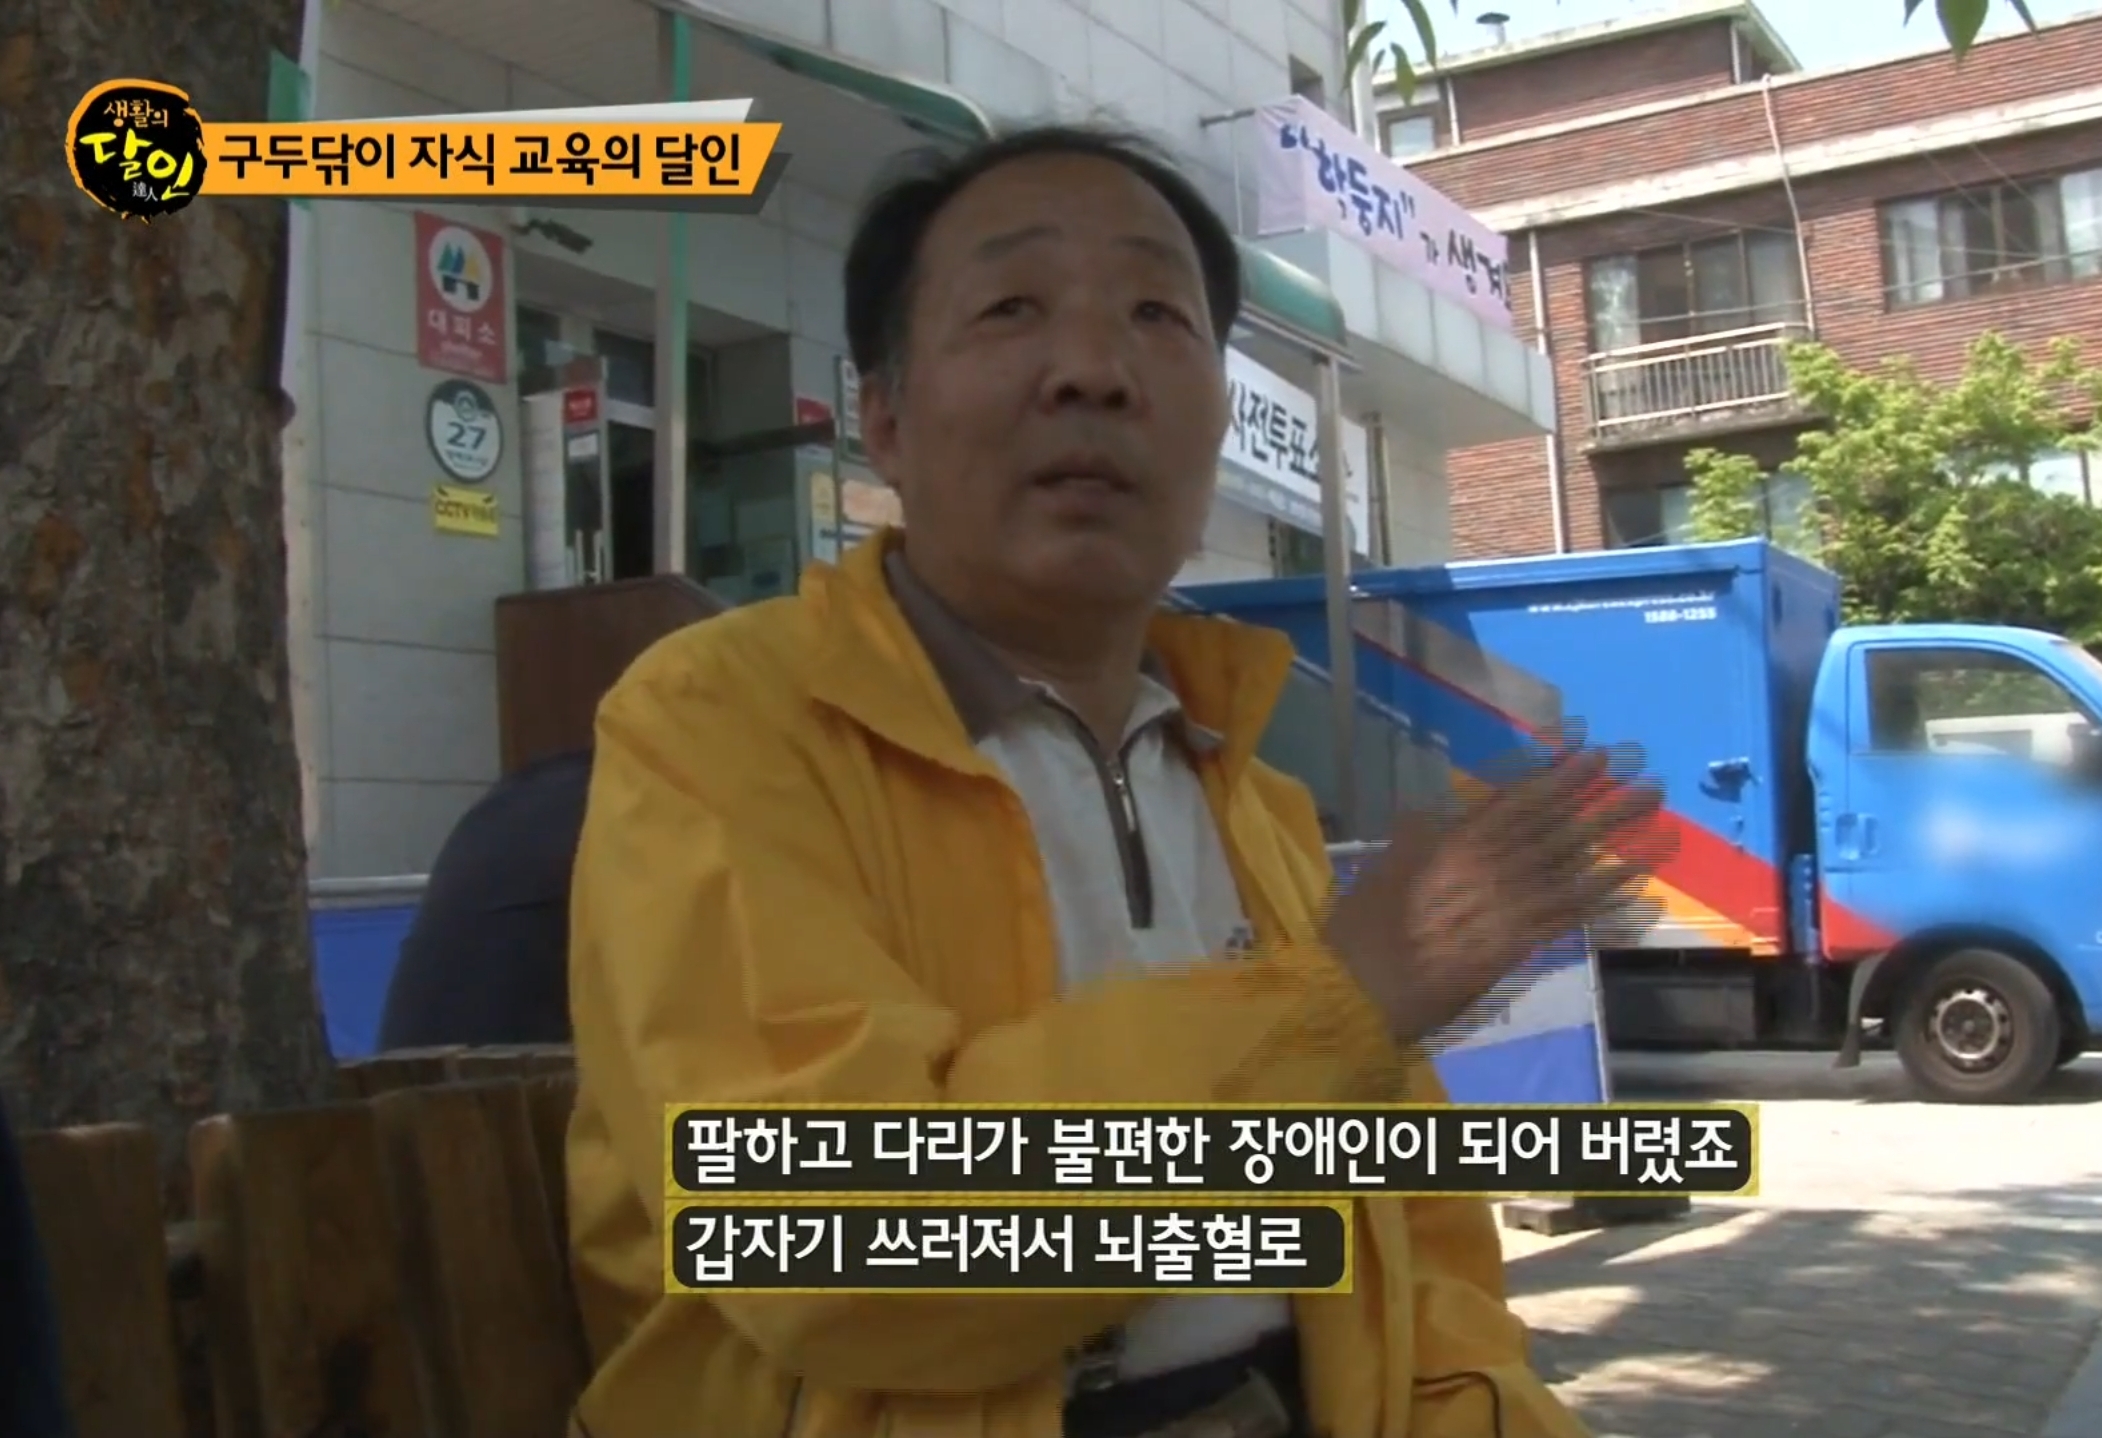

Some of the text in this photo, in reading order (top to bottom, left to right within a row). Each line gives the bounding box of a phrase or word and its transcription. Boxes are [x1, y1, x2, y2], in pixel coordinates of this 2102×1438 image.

[1420, 231, 1440, 266] 가
[427, 309, 496, 346] 대피소
[447, 421, 487, 450] 27
[1228, 377, 1353, 484] 사전투표
